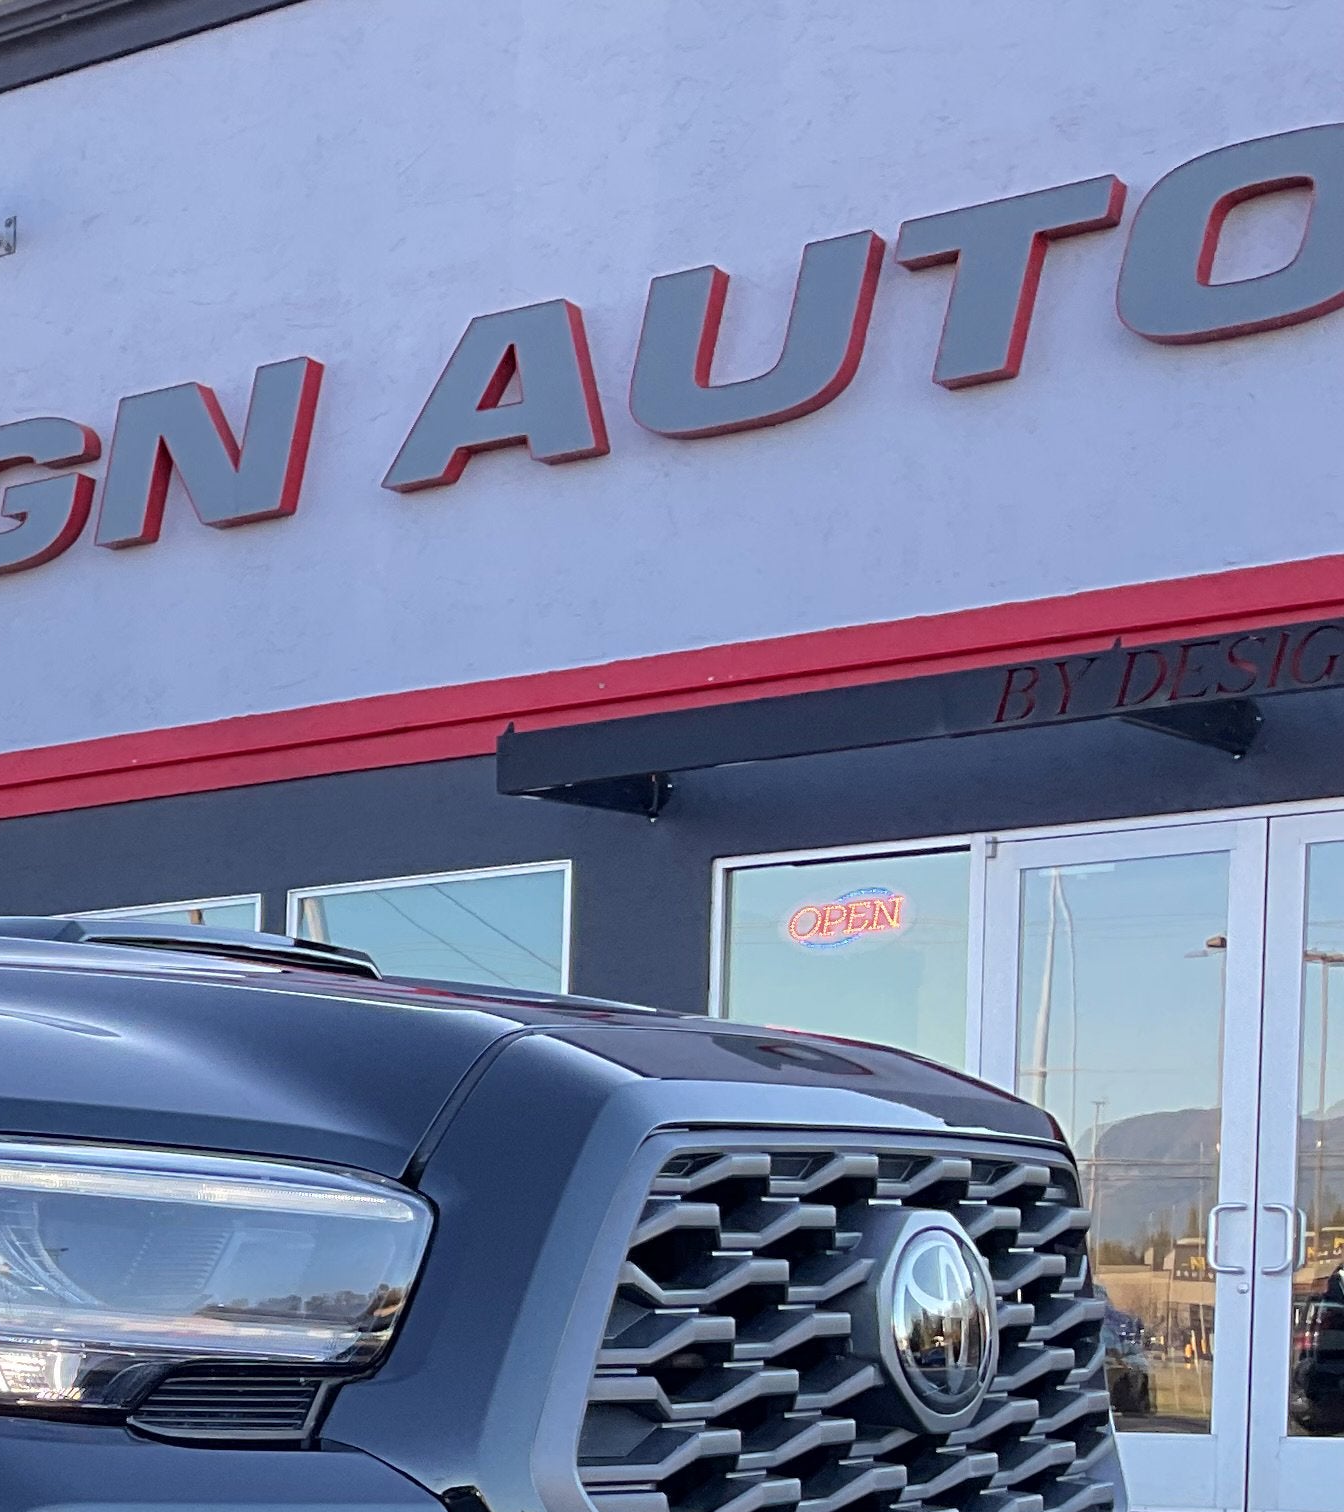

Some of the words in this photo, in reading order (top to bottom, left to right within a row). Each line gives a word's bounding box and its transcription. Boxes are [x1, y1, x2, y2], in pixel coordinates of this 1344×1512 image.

[381, 122, 1344, 494] AUTO
[993, 656, 1099, 723] BY
[1114, 624, 1344, 708] DESIG
[788, 894, 905, 941] OPEN
